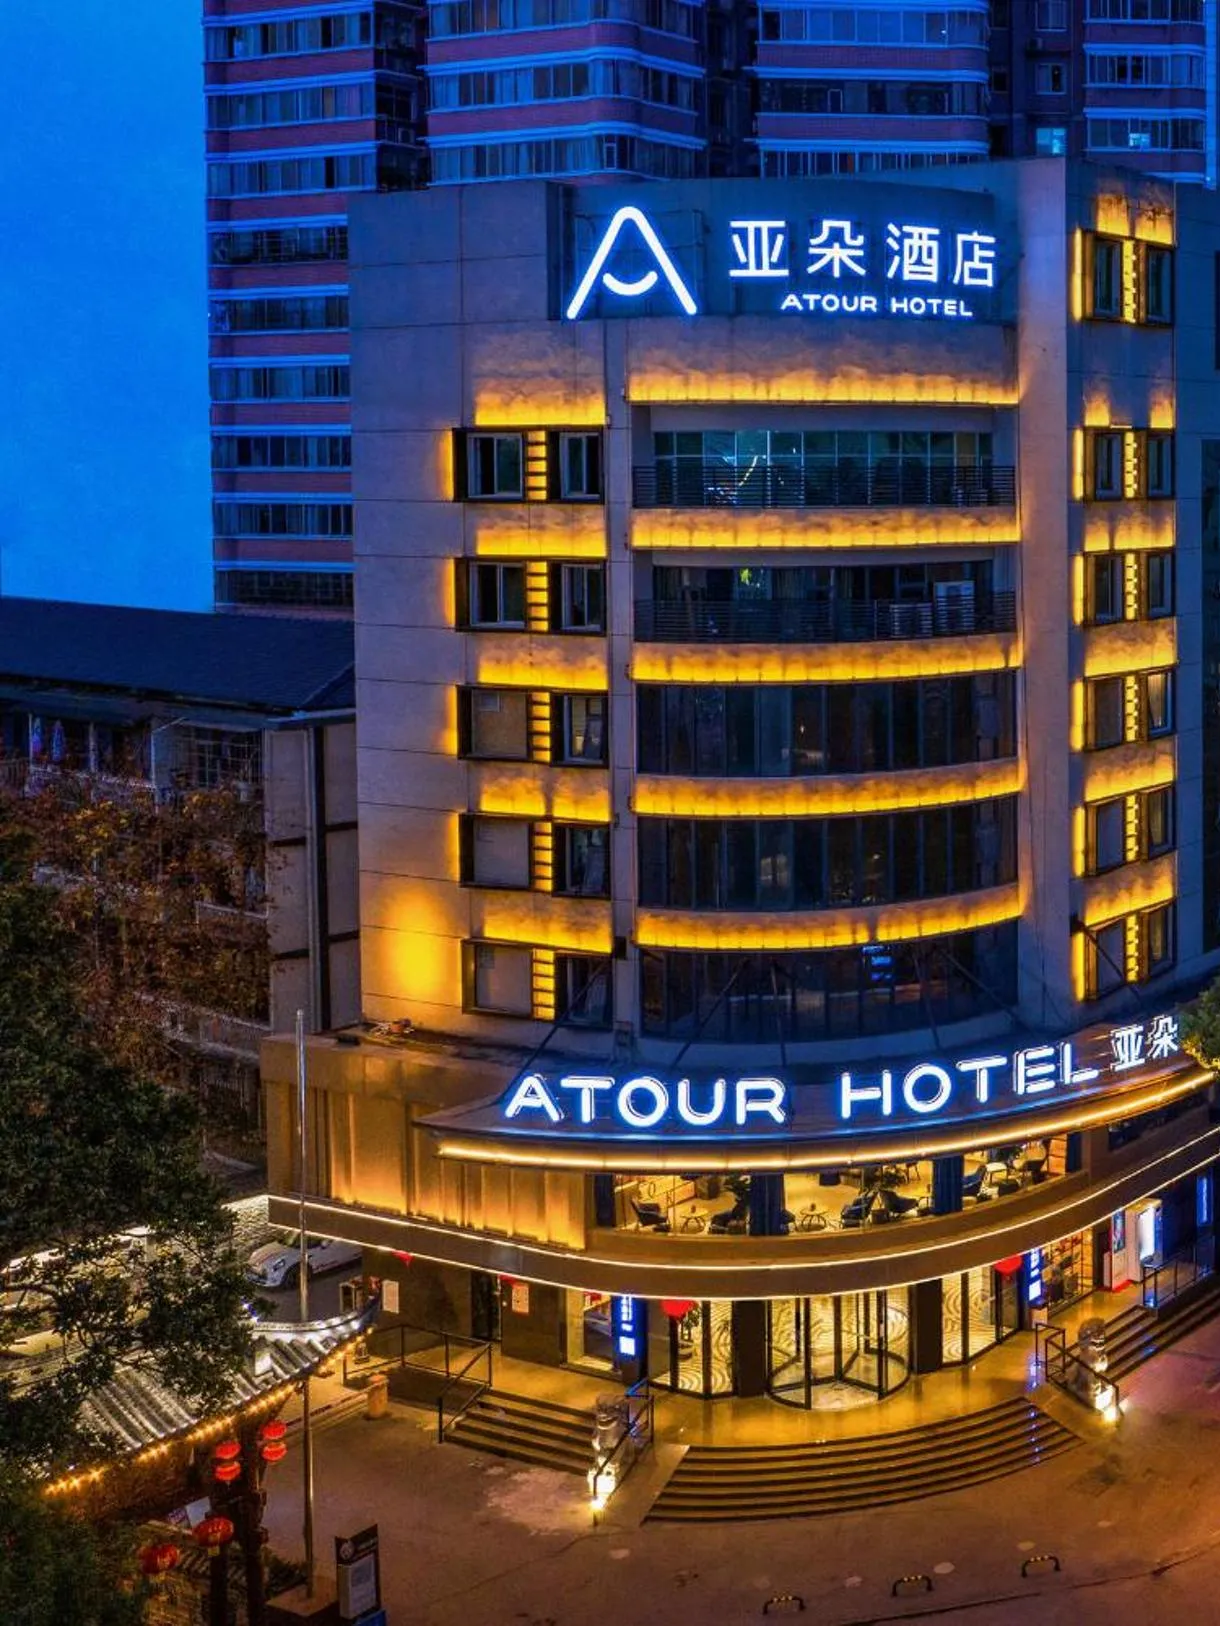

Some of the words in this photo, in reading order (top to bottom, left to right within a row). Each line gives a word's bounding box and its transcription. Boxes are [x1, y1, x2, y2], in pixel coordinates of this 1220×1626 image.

[729, 219, 996, 287] 亚朵酒店
[780, 293, 878, 312] ATOUR
[890, 297, 973, 317] HOTEL
[1109, 1014, 1179, 1072] 亚朵
[504, 1073, 787, 1127] ATOUR
[841, 1042, 1099, 1120] HOTEL
